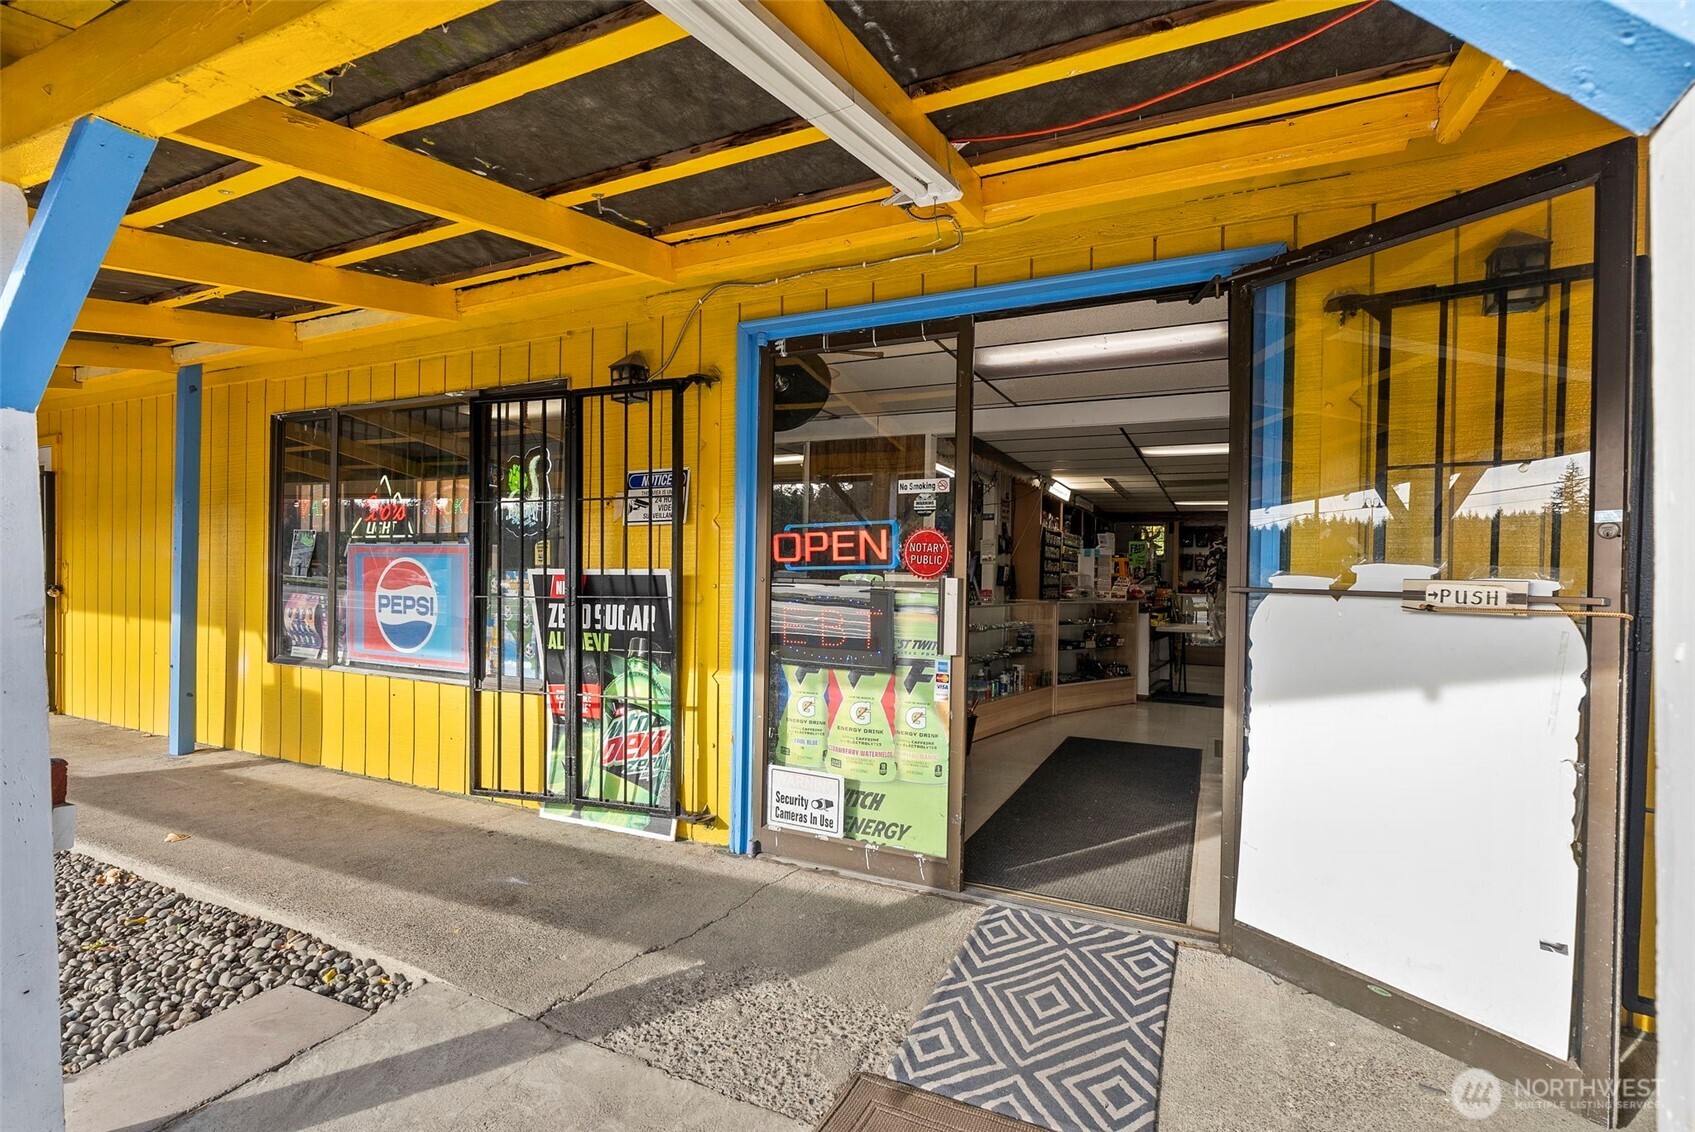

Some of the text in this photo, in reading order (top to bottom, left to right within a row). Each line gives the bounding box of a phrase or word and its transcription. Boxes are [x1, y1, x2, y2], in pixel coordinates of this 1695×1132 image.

[899, 482, 936, 492] No Smoking
[657, 504, 673, 512] VIDE
[773, 528, 888, 562] OPEN
[909, 542, 945, 553] NOTARY
[910, 554, 943, 565] PUBLIC
[378, 594, 434, 616] PEPSI
[1440, 588, 1499, 606] PUSH
[548, 603, 656, 632] ZEO SUGAR
[837, 725, 862, 733] ENERGY
[775, 791, 809, 810] Security
[775, 806, 834, 829] Cameras In Use
[844, 815, 912, 841] ENERGY
